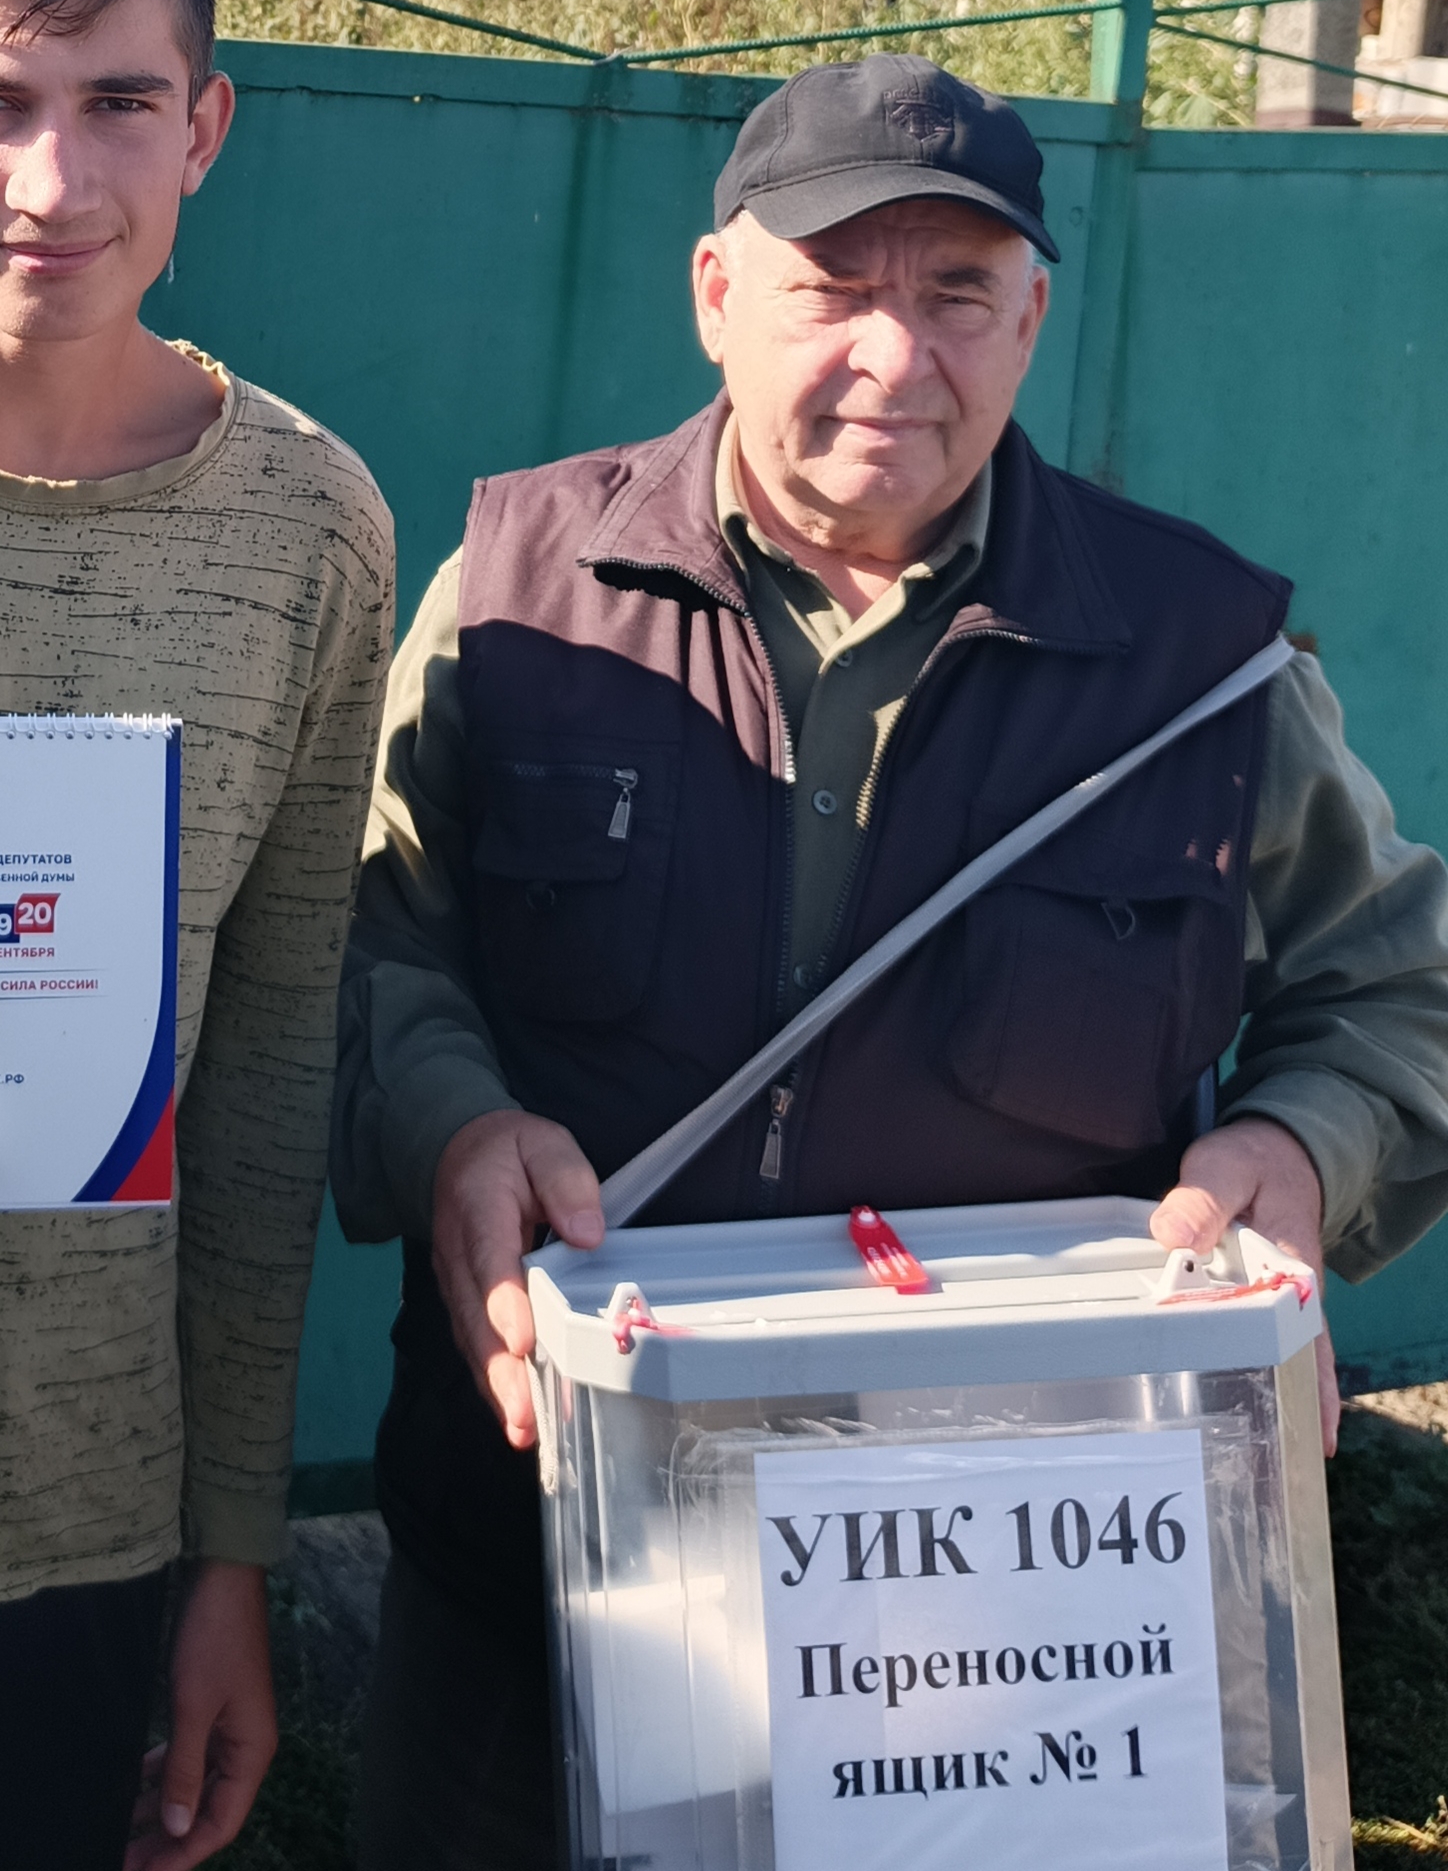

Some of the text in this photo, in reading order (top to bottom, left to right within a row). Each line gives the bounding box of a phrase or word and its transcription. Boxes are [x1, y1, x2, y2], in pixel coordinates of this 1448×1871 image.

[41, 873, 75, 883] ДУМЫ
[18, 902, 52, 925] 20
[0, 980, 37, 991] СИЛА
[40, 979, 99, 990] РОССИИ!
[766, 1492, 1186, 1587] УИК 1046
[795, 1623, 1174, 1708] Переносной
[832, 1724, 1148, 1800] ящик № 1
